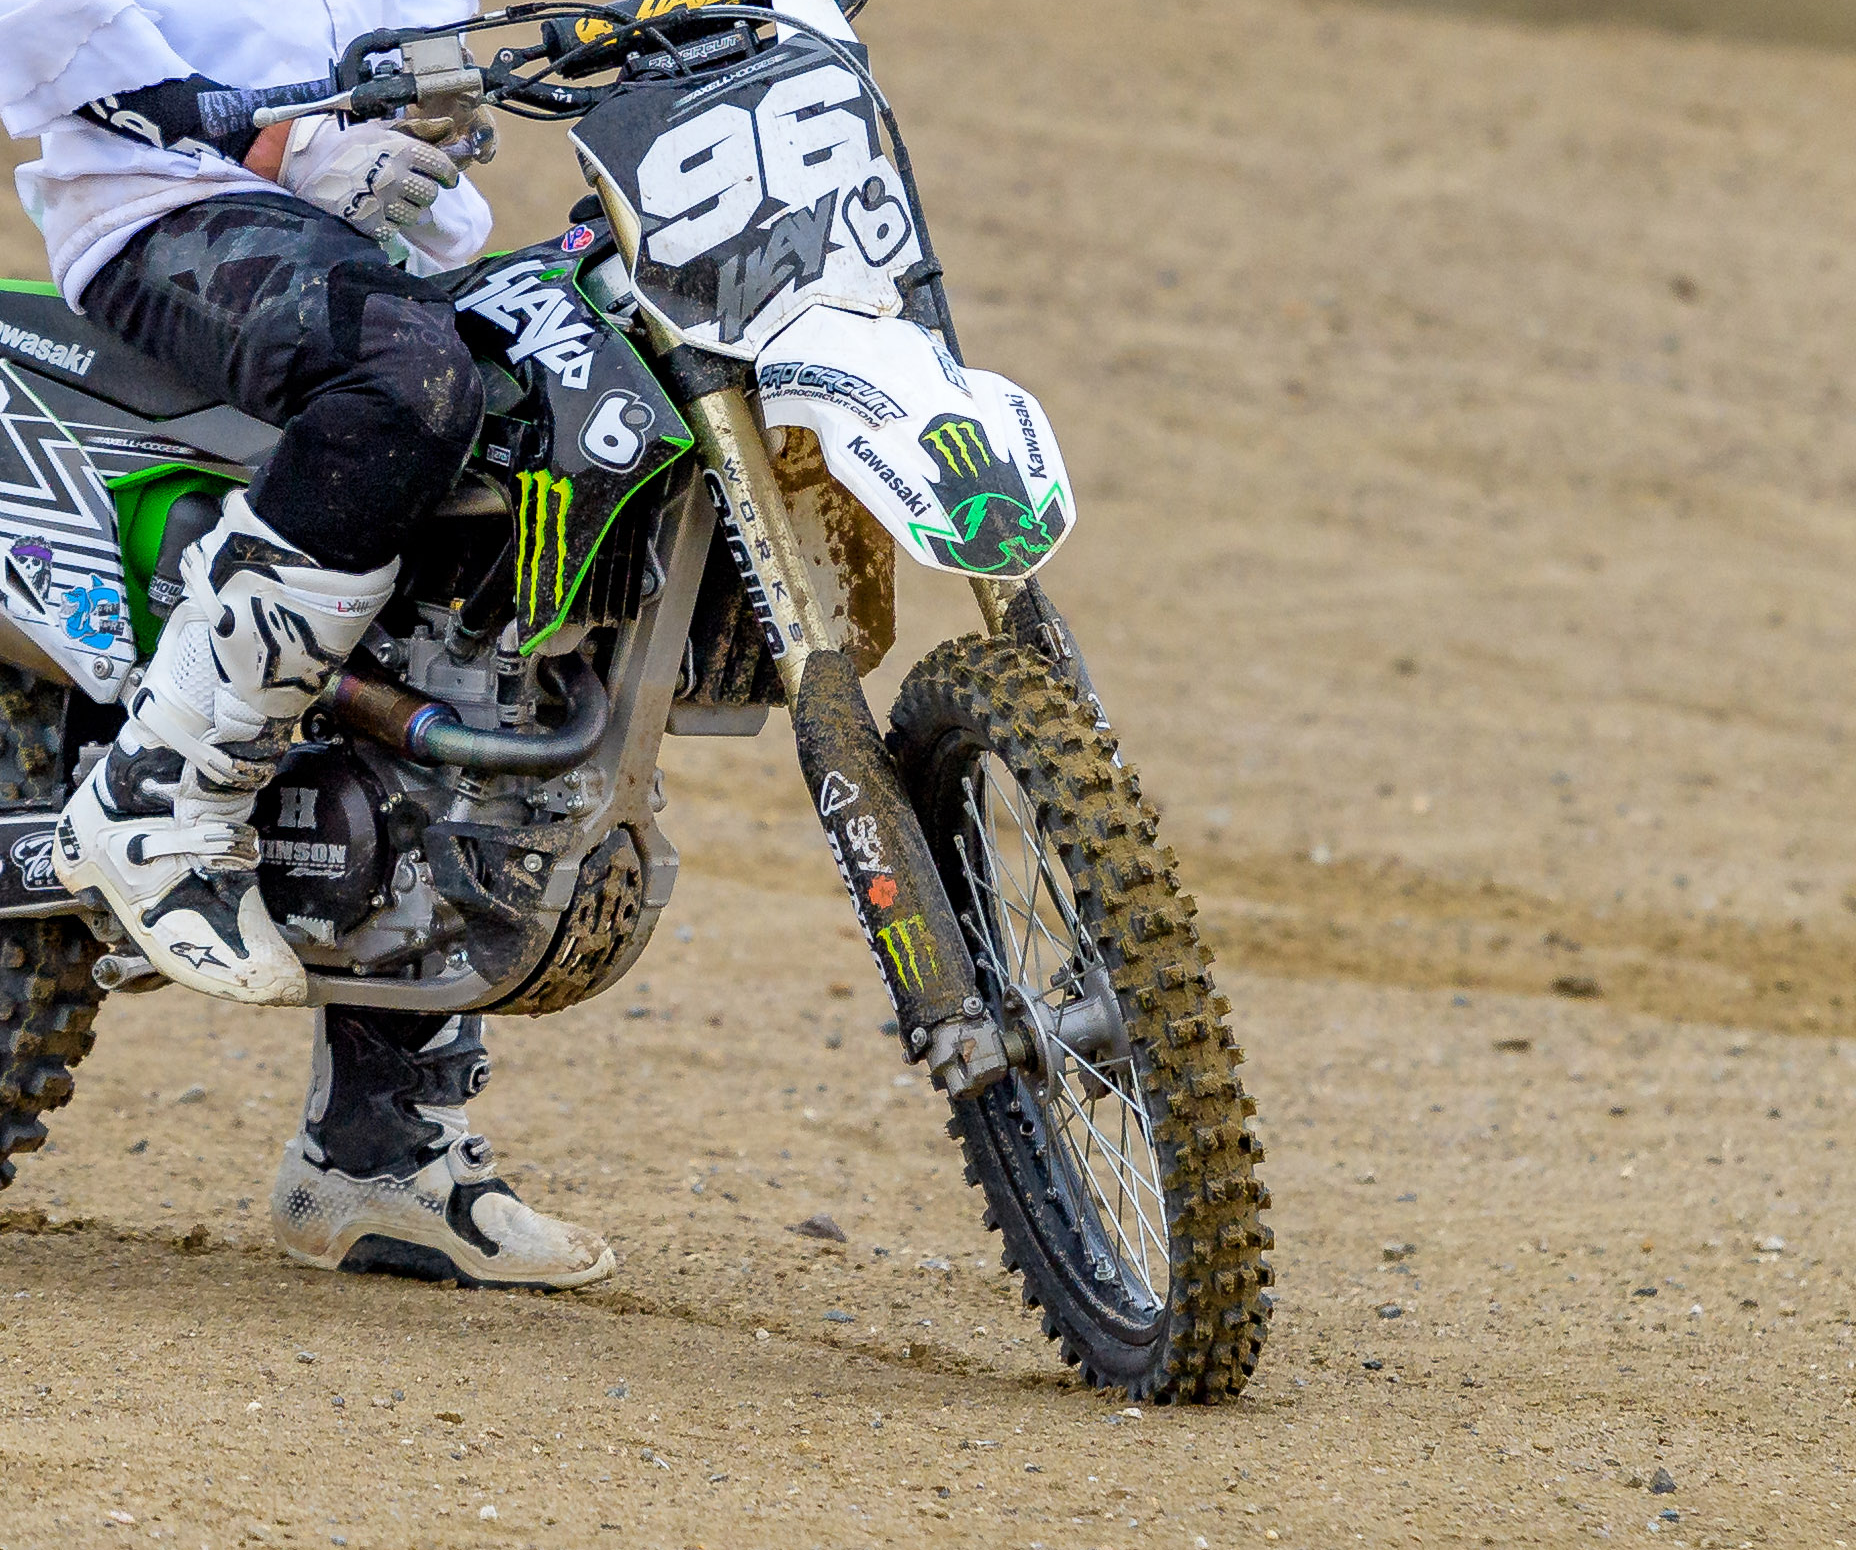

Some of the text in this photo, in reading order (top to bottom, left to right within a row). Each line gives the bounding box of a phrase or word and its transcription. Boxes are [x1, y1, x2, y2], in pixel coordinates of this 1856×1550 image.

[635, 65, 870, 268] 96
[760, 361, 909, 421] PRO CIRCUIT
[848, 435, 933, 519] Kawasaki
[1004, 392, 1048, 480] Kawasaki
